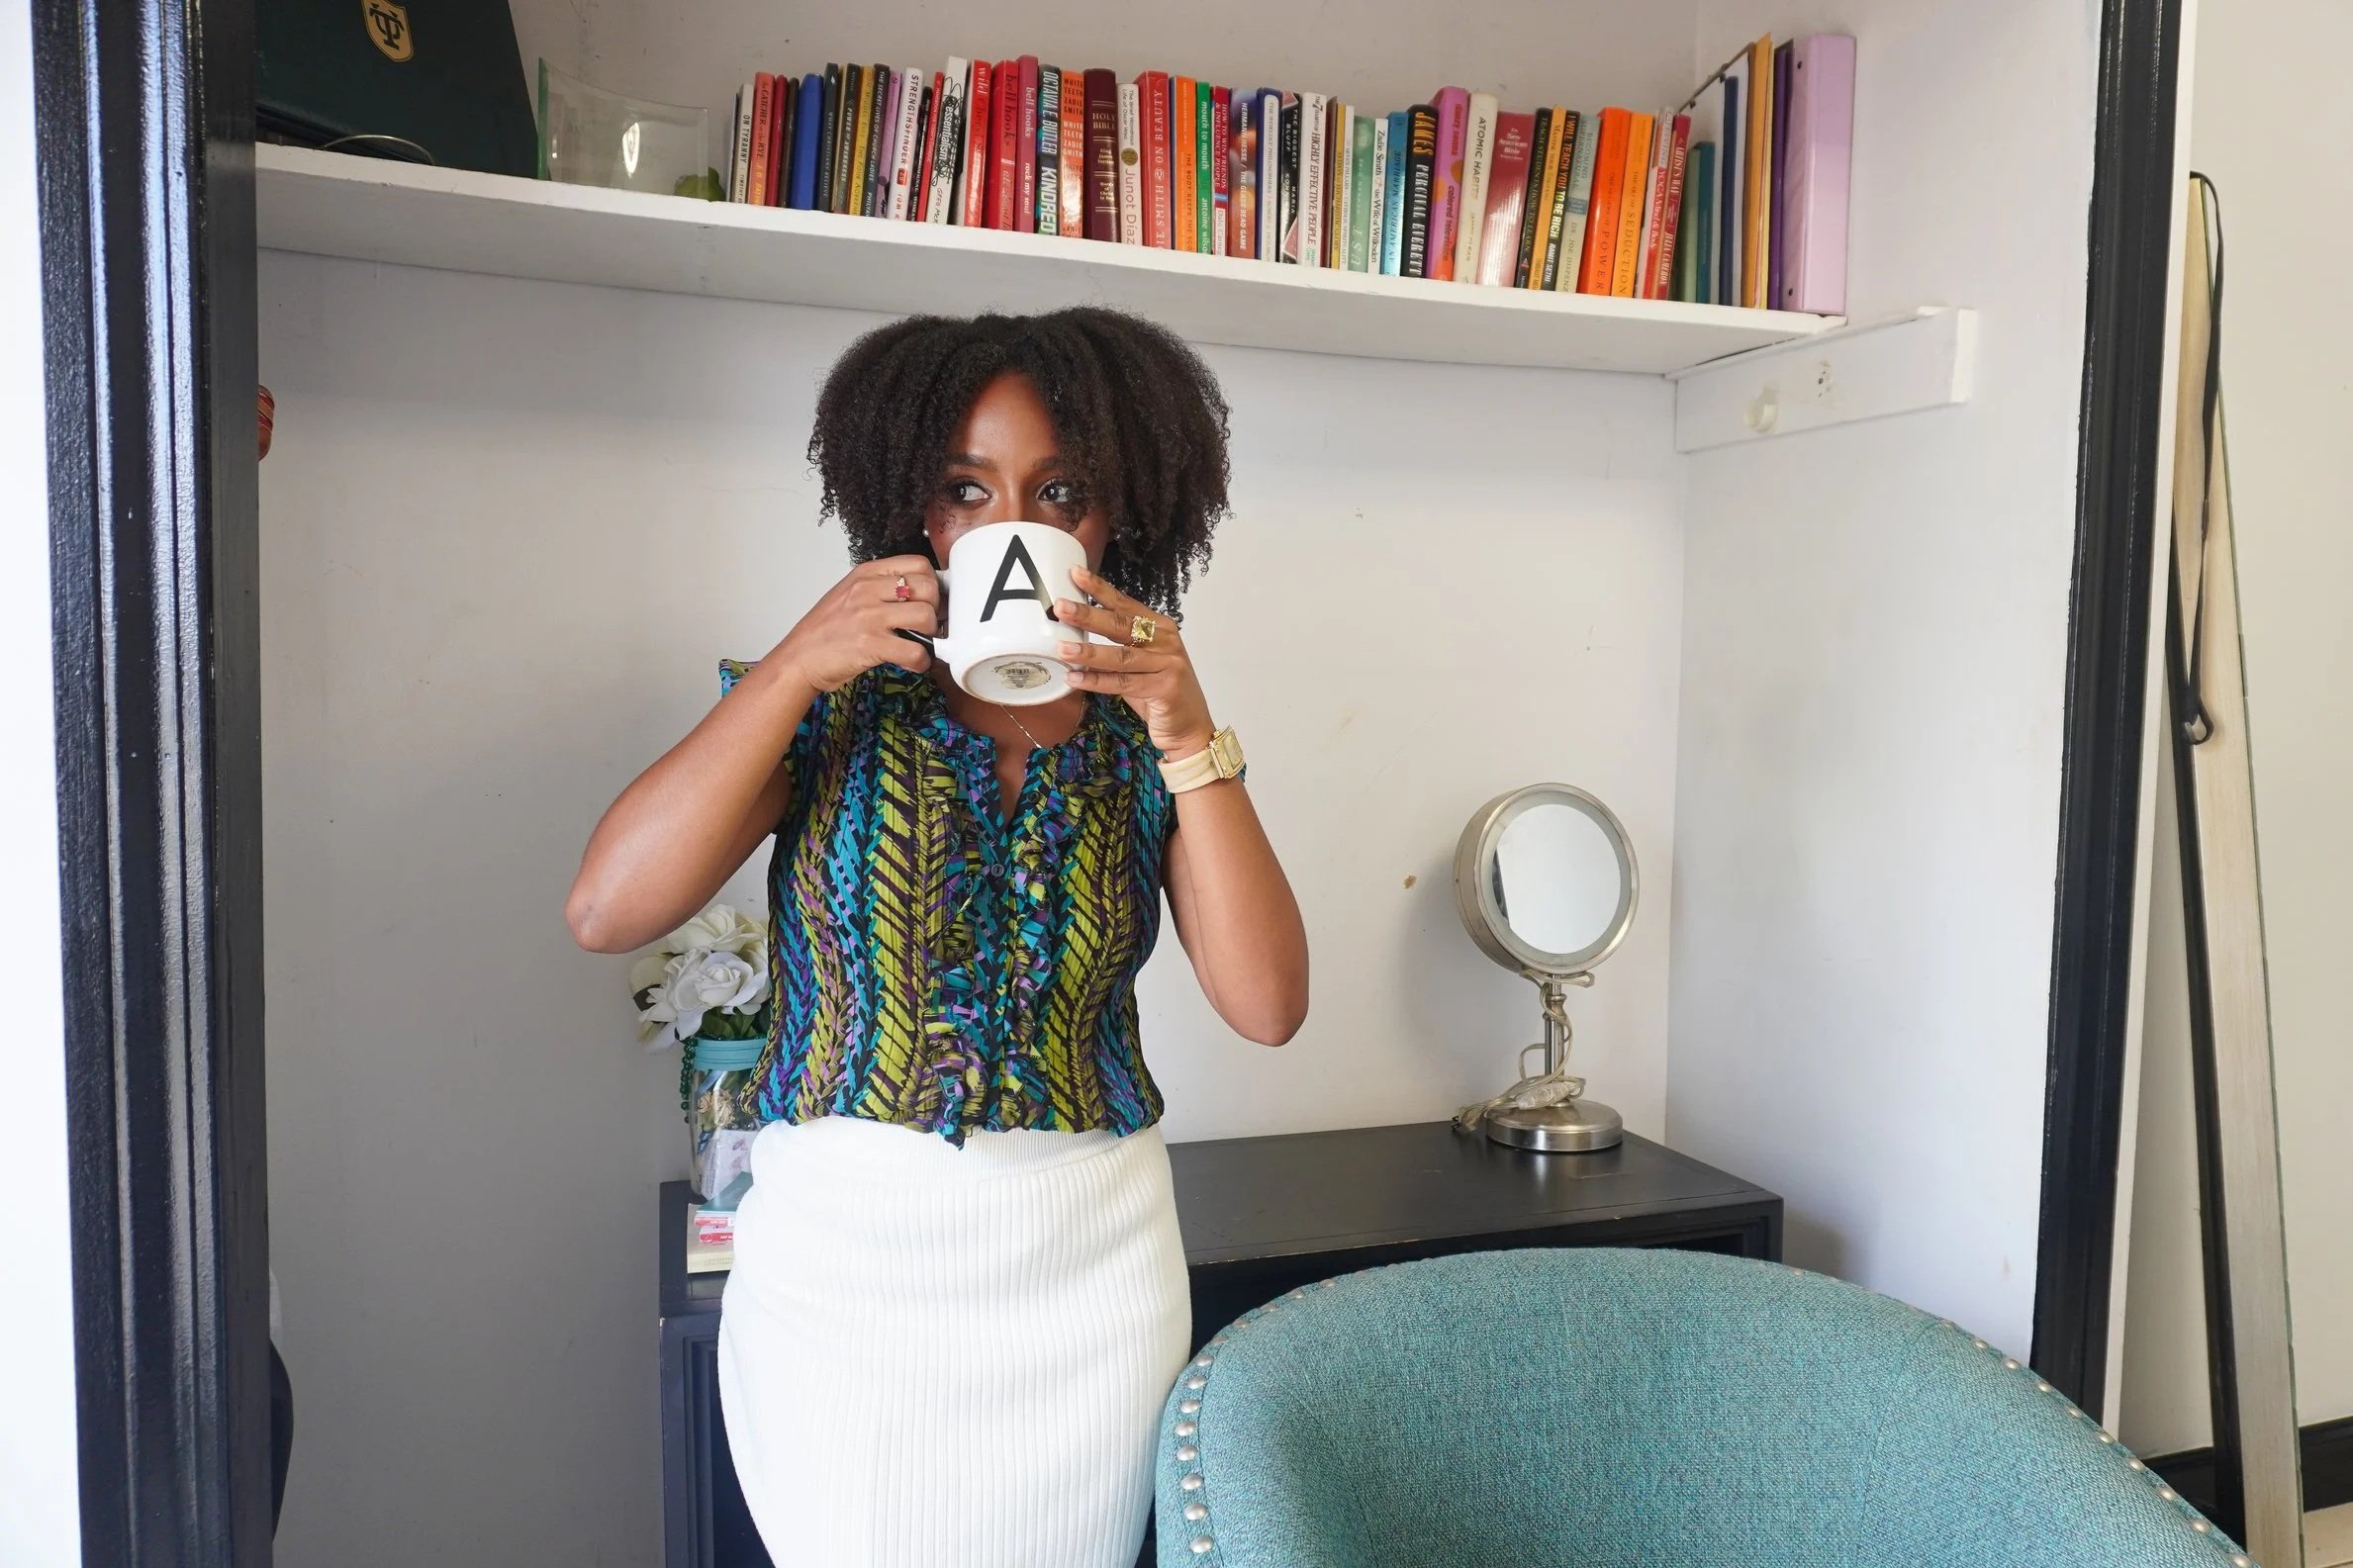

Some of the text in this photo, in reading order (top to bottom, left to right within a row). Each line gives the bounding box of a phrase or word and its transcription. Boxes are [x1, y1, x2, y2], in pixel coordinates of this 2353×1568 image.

[978, 67, 988, 95] wild
[1043, 71, 1059, 109] OCTAVIA
[1064, 78, 1083, 88] WHITE
[759, 89, 769, 125] CATCHER
[900, 74, 919, 164] STRENGTHSFINDER
[1003, 73, 1016, 146] bell hooks
[1024, 87, 1035, 138] bell hooks
[1064, 97, 1082, 107] ZADIE
[1092, 113, 1115, 122] HOLY
[740, 114, 750, 163] ON TYRANNY
[939, 106, 953, 161] essentialism
[1041, 120, 1058, 154] BUTLER
[1064, 121, 1083, 130] WHITE
[1064, 131, 1083, 139] TEETH
[1154, 90, 1163, 163] ON BEAUTY
[1201, 131, 1208, 140] to
[1221, 125, 1227, 136] TO
[1412, 112, 1436, 156] JAMES
[1451, 104, 1462, 156] danzy senna
[1475, 117, 1487, 158] ATOMIC
[1564, 120, 1575, 140] WILL
[841, 140, 850, 182] AWARENESS
[1064, 148, 1083, 157] SMITH
[1310, 133, 1320, 163] HIGHLY
[1374, 130, 1385, 175] Zadie Smith
[1560, 142, 1572, 169] TEACH
[1571, 120, 1587, 190] SUPERNATURAL
[1581, 132, 1594, 179] BECOMING
[1671, 145, 1685, 177] ARTIST'S
[1023, 182, 1030, 196] my
[1308, 164, 1319, 211] EFFECTIVE
[1470, 161, 1480, 201] HABITS
[1525, 117, 1549, 253] TEACH STUDENTS HOW TO LEARN
[1556, 171, 1569, 189] YOU
[1556, 190, 1565, 202] TO
[1656, 170, 1666, 198] YOGA
[1670, 178, 1681, 196] WAY
[1040, 166, 1057, 233] KINDRED
[1125, 168, 1137, 244] Junot Díaz
[1156, 184, 1165, 226] SMITH
[1372, 199, 1381, 220] Wife
[1389, 150, 1402, 247] AMERICAN MARRIAGE
[1553, 203, 1564, 216] BE
[1652, 199, 1662, 222] Mind
[1307, 213, 1317, 245] PEOPLE
[1408, 164, 1429, 276] PERCIVAL EVERETT
[1442, 185, 1456, 261] colored television
[1550, 217, 1562, 238] RICH
[1619, 212, 1636, 294] SEDUCTION
[1649, 231, 1659, 249] Body
[1664, 231, 1674, 251] JULIA
[1545, 242, 1556, 283] RAMIT SETHI
[1596, 231, 1610, 291] POWER
[1659, 252, 1671, 286] CAMERON
[980, 534, 1059, 622] A
